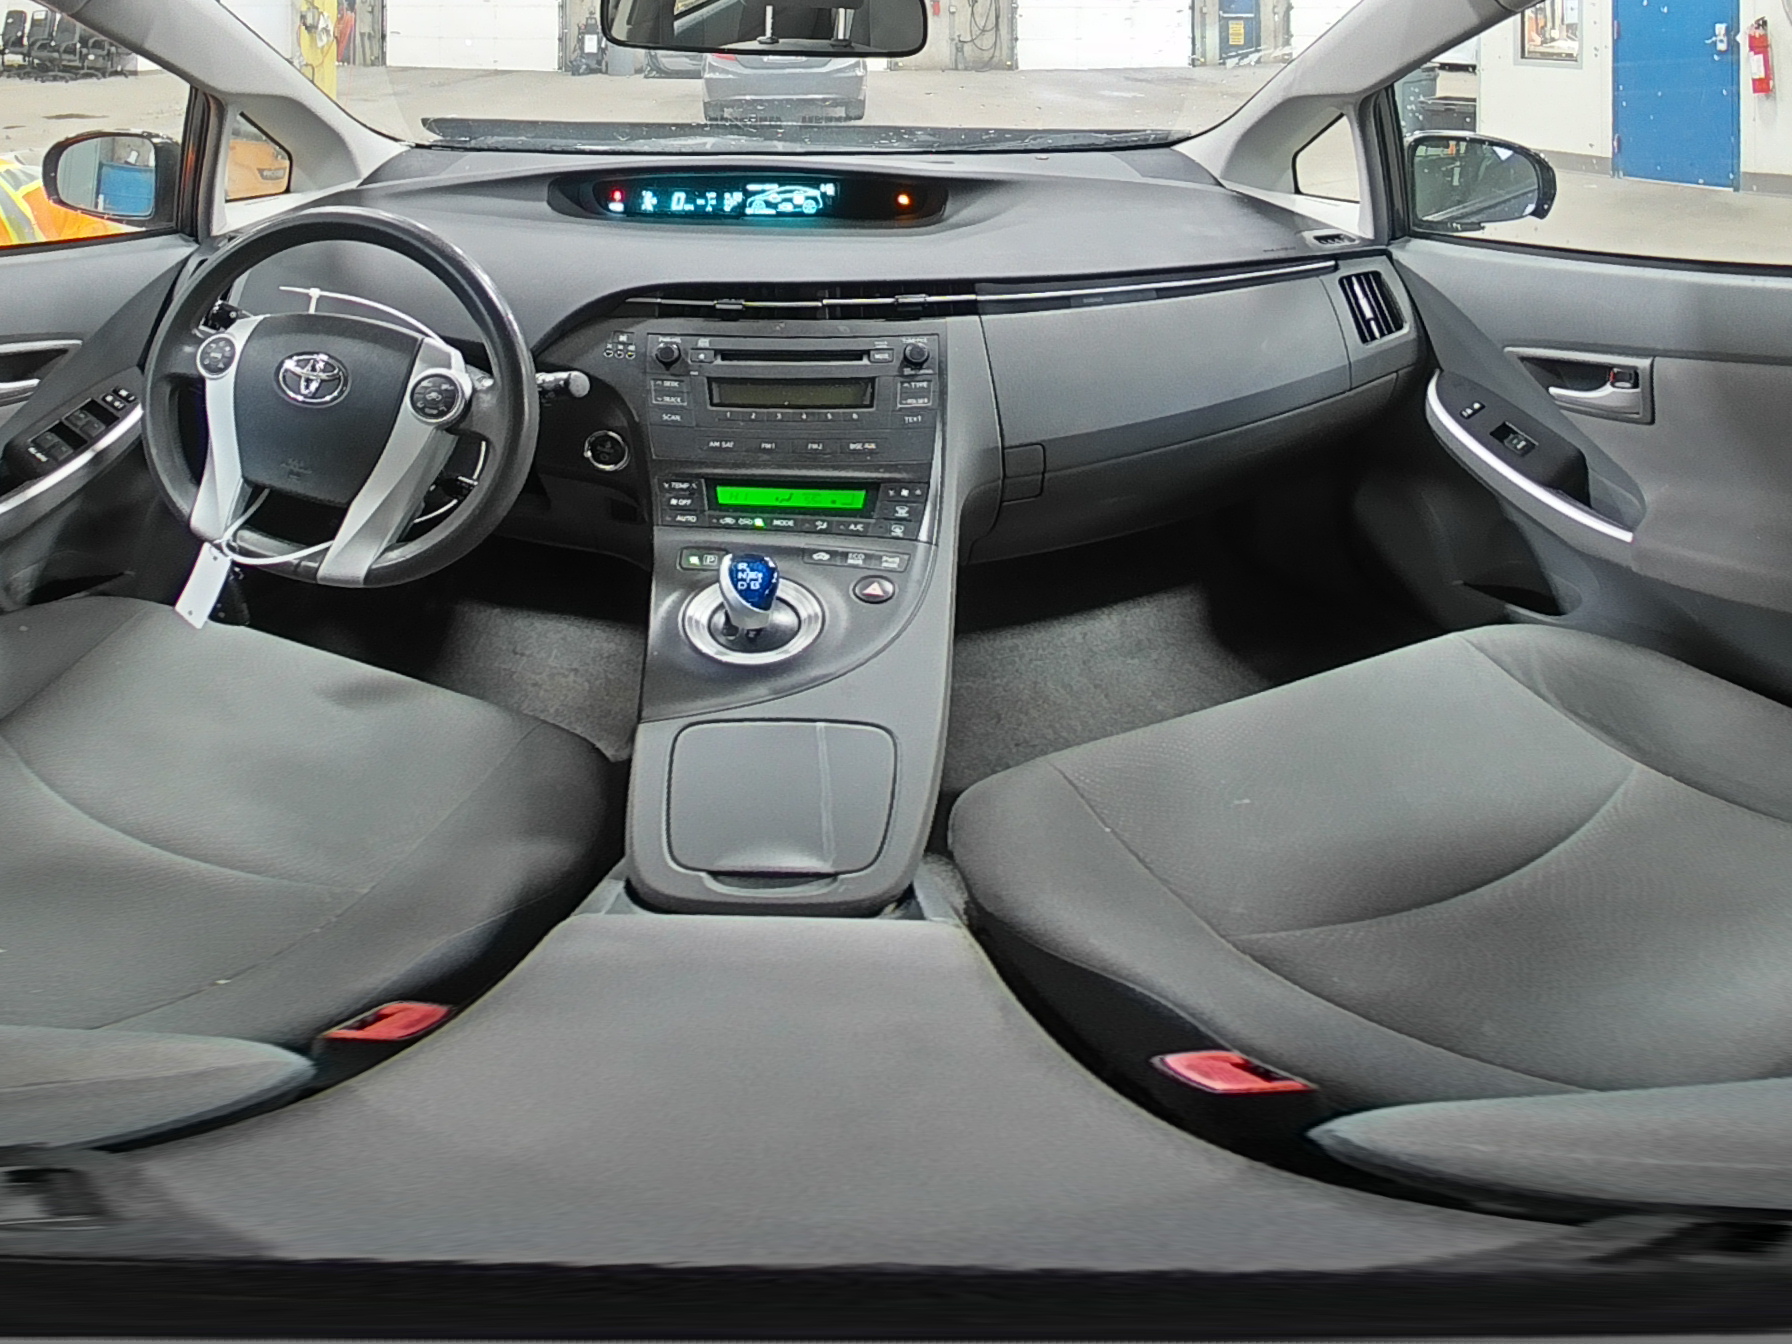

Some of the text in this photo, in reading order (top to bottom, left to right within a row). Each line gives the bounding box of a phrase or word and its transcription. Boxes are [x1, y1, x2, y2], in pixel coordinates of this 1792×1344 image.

[662, 413, 682, 421] SCAN
[903, 415, 922, 423] TEXT
[849, 523, 864, 531] A/C
[848, 552, 865, 560] ECO
[737, 562, 748, 570] R
[737, 571, 748, 579] N
[737, 581, 747, 589] D
